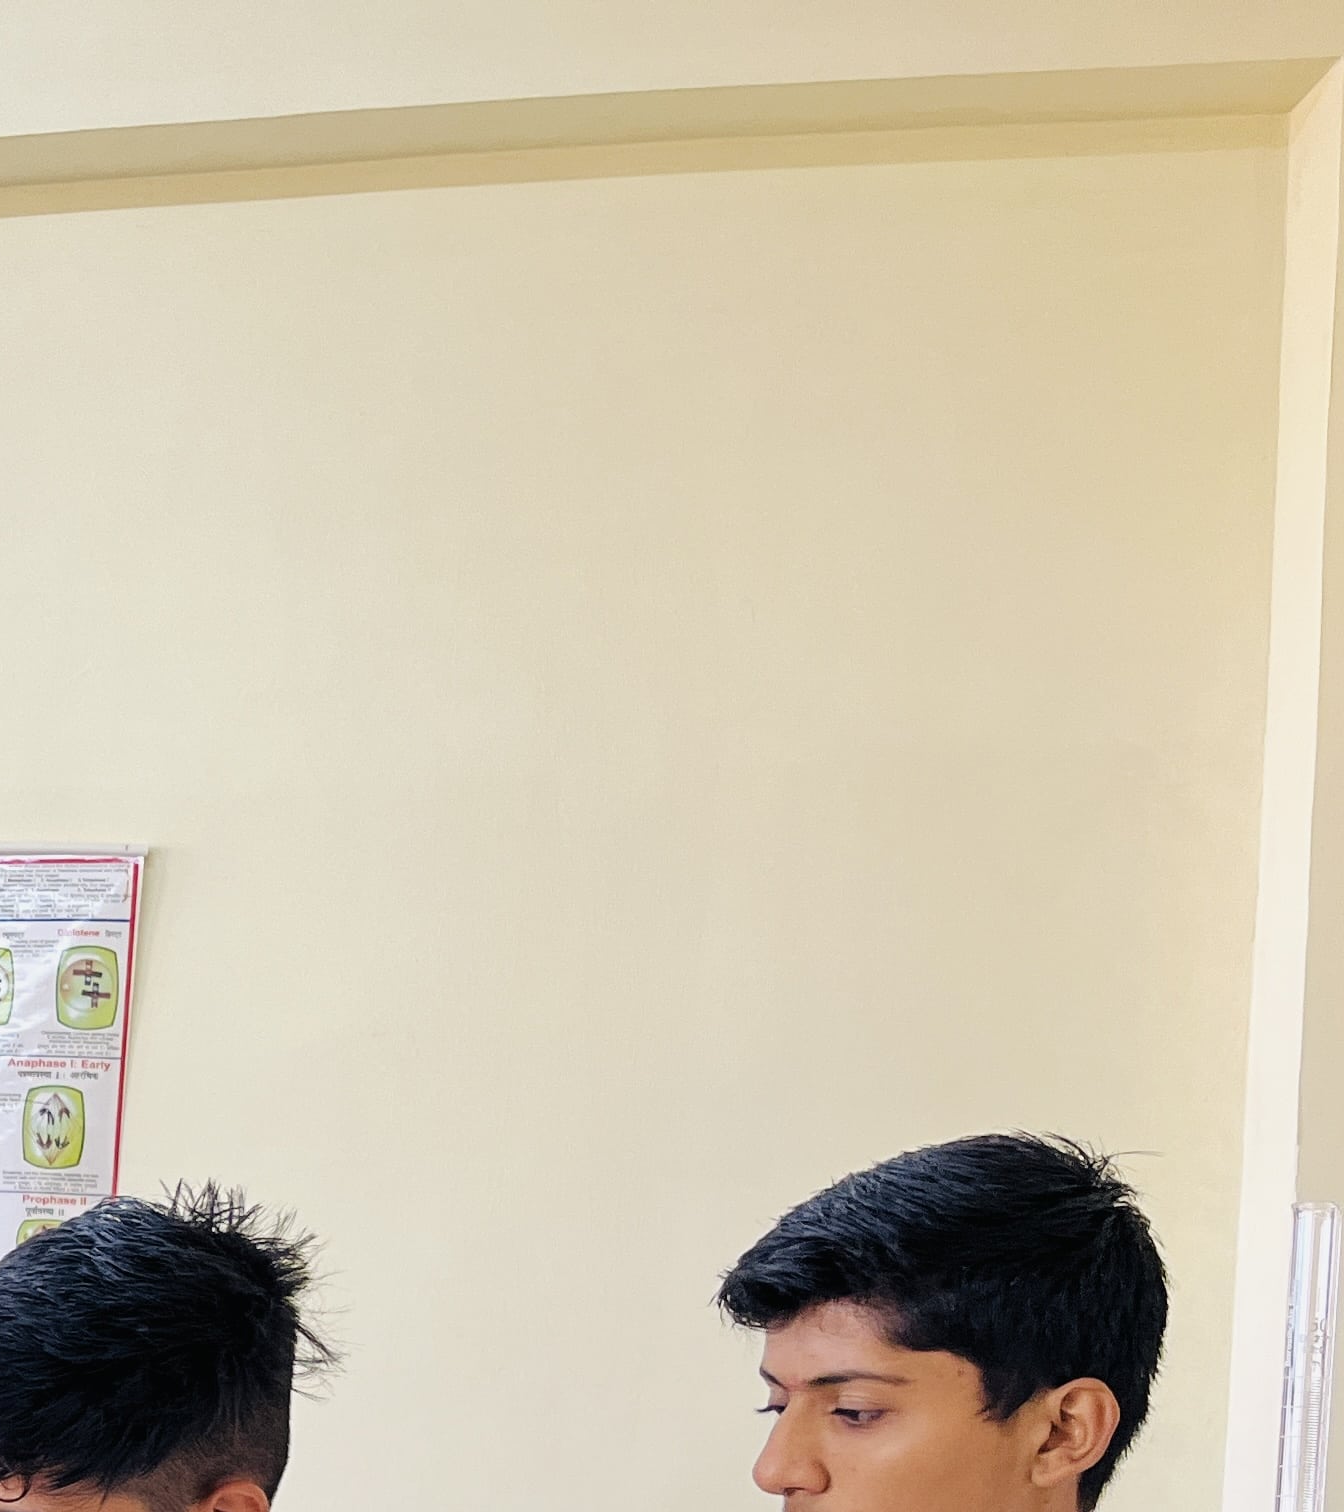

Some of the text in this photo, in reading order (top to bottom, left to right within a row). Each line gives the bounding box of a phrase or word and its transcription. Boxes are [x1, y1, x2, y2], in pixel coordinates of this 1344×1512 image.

[7, 1058, 66, 1069] Anaphase
[81, 1060, 111, 1072] Early
[22, 1195, 87, 1206] Prophase II
